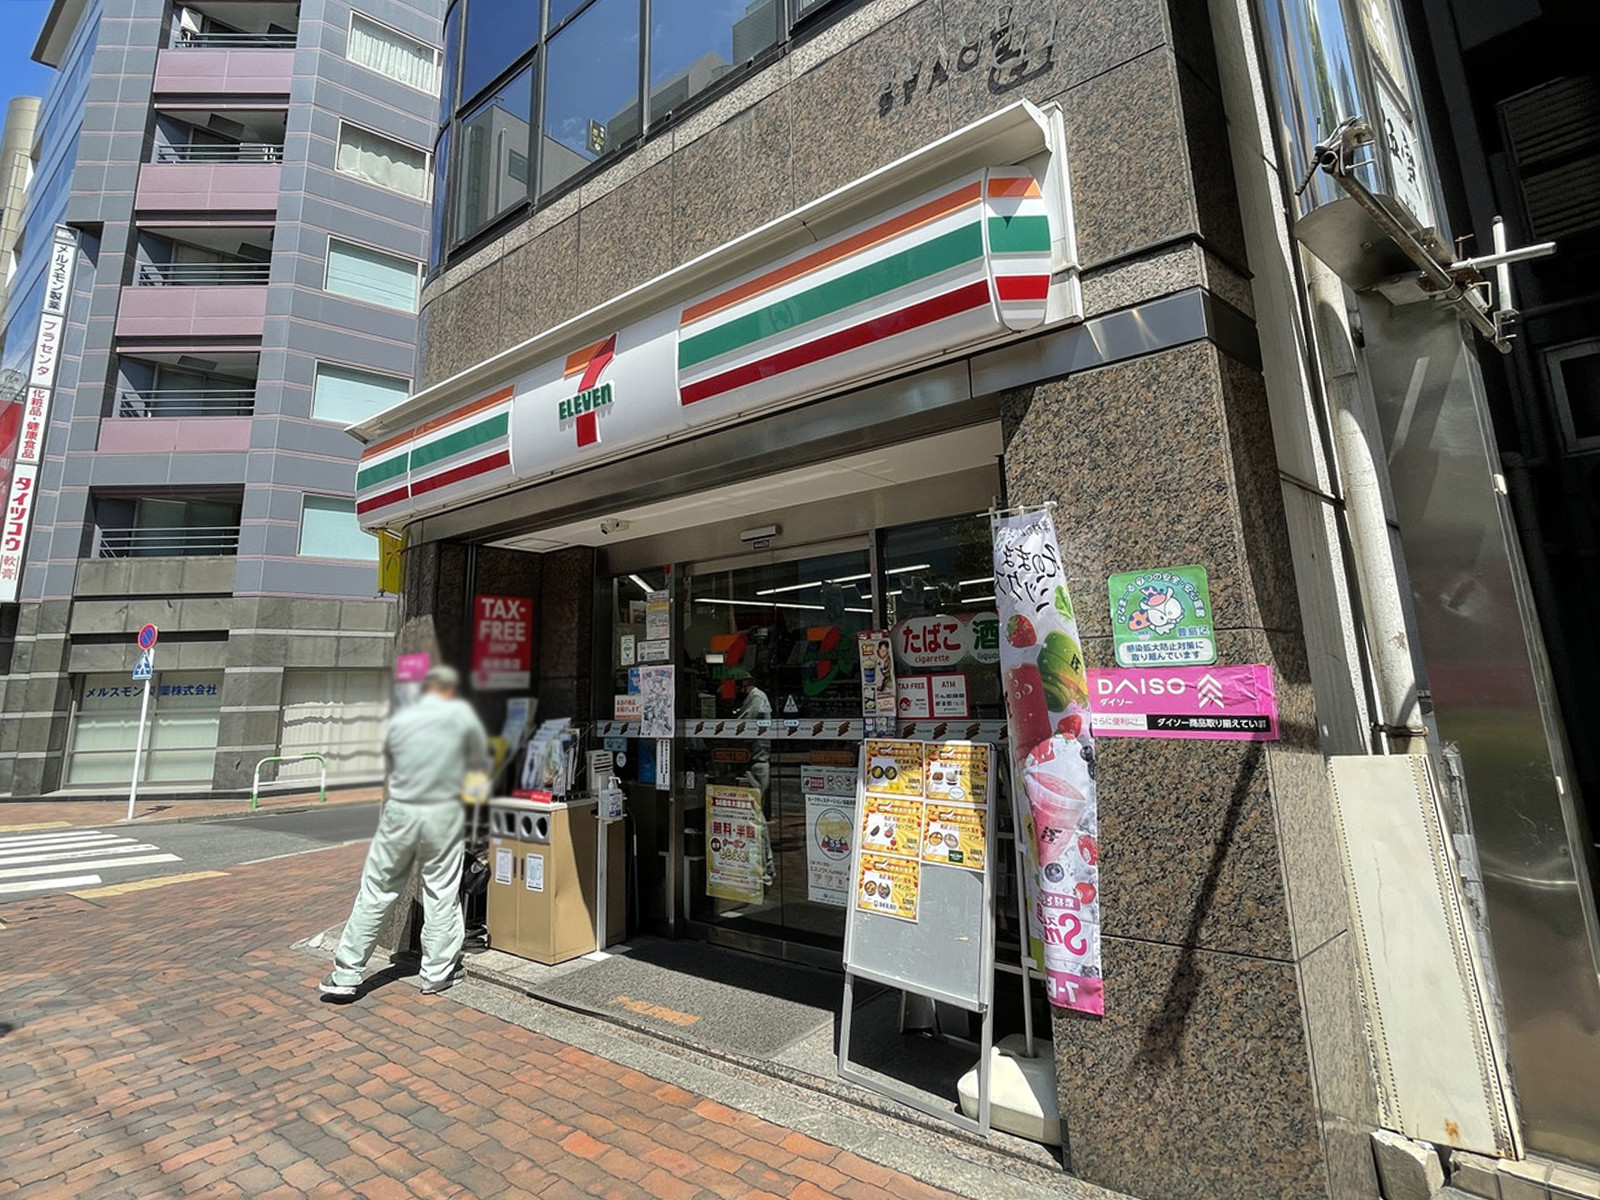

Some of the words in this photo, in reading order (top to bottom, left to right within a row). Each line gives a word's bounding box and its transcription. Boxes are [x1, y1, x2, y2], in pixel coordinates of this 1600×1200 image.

[49, 245, 69, 310] メルスモン製薬
[37, 320, 58, 376] プラセンタ
[21, 388, 46, 459] 化粧品・健康食品
[5, 477, 31, 551] タイツコウ
[481, 598, 526, 619] TAX-
[479, 621, 526, 641] FREE
[903, 623, 961, 653] たばこ
[972, 619, 999, 649] 酒
[1126, 641, 1204, 653] 感染拡大防止対策に
[1131, 650, 1200, 661] 取り組んでいます
[915, 655, 950, 664] cigarette
[86, 684, 217, 698] メルスモン薬株式会社
[941, 680, 956, 688] ATM
[1097, 677, 1186, 695] DAISO
[1100, 698, 1133, 707] ダイソー
